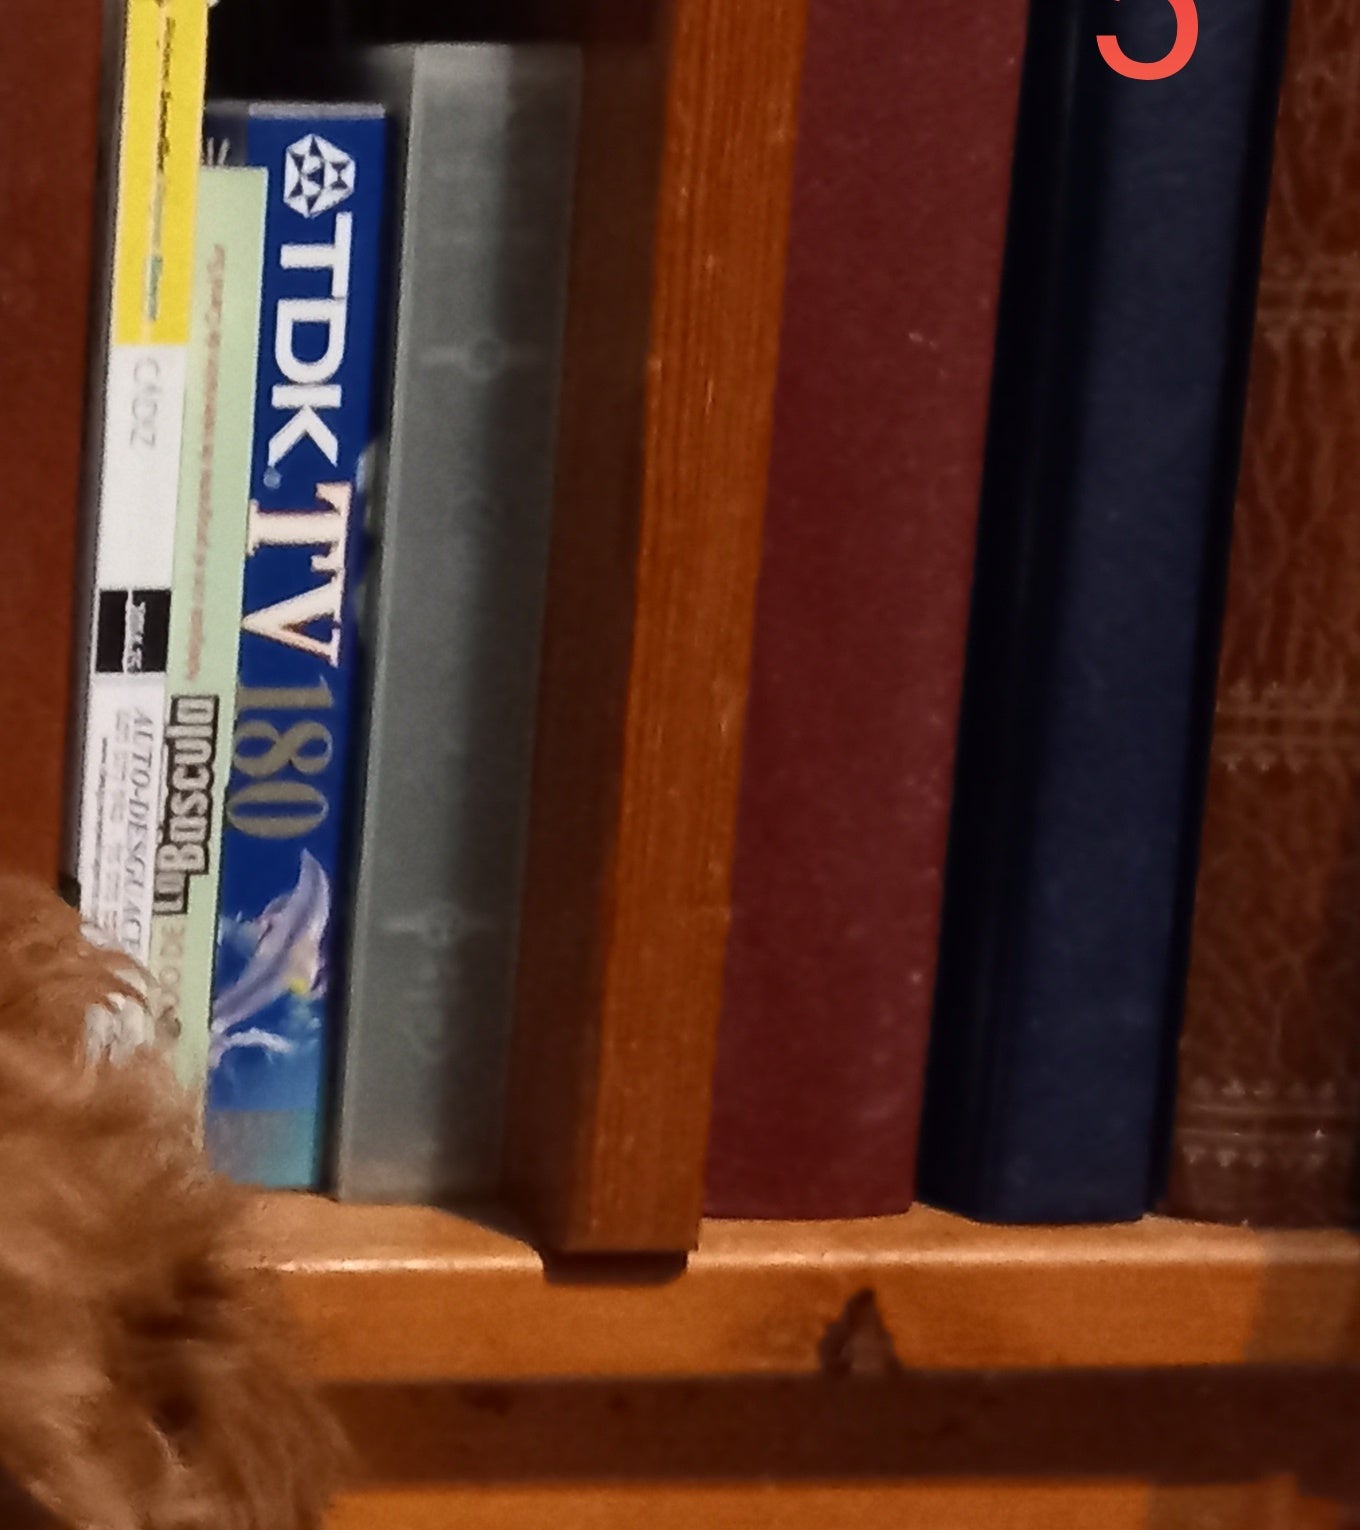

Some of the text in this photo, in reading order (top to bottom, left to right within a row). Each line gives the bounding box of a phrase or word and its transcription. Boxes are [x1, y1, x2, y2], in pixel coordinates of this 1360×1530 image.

[268, 211, 353, 468] TDK
[226, 481, 353, 840] TV 180
